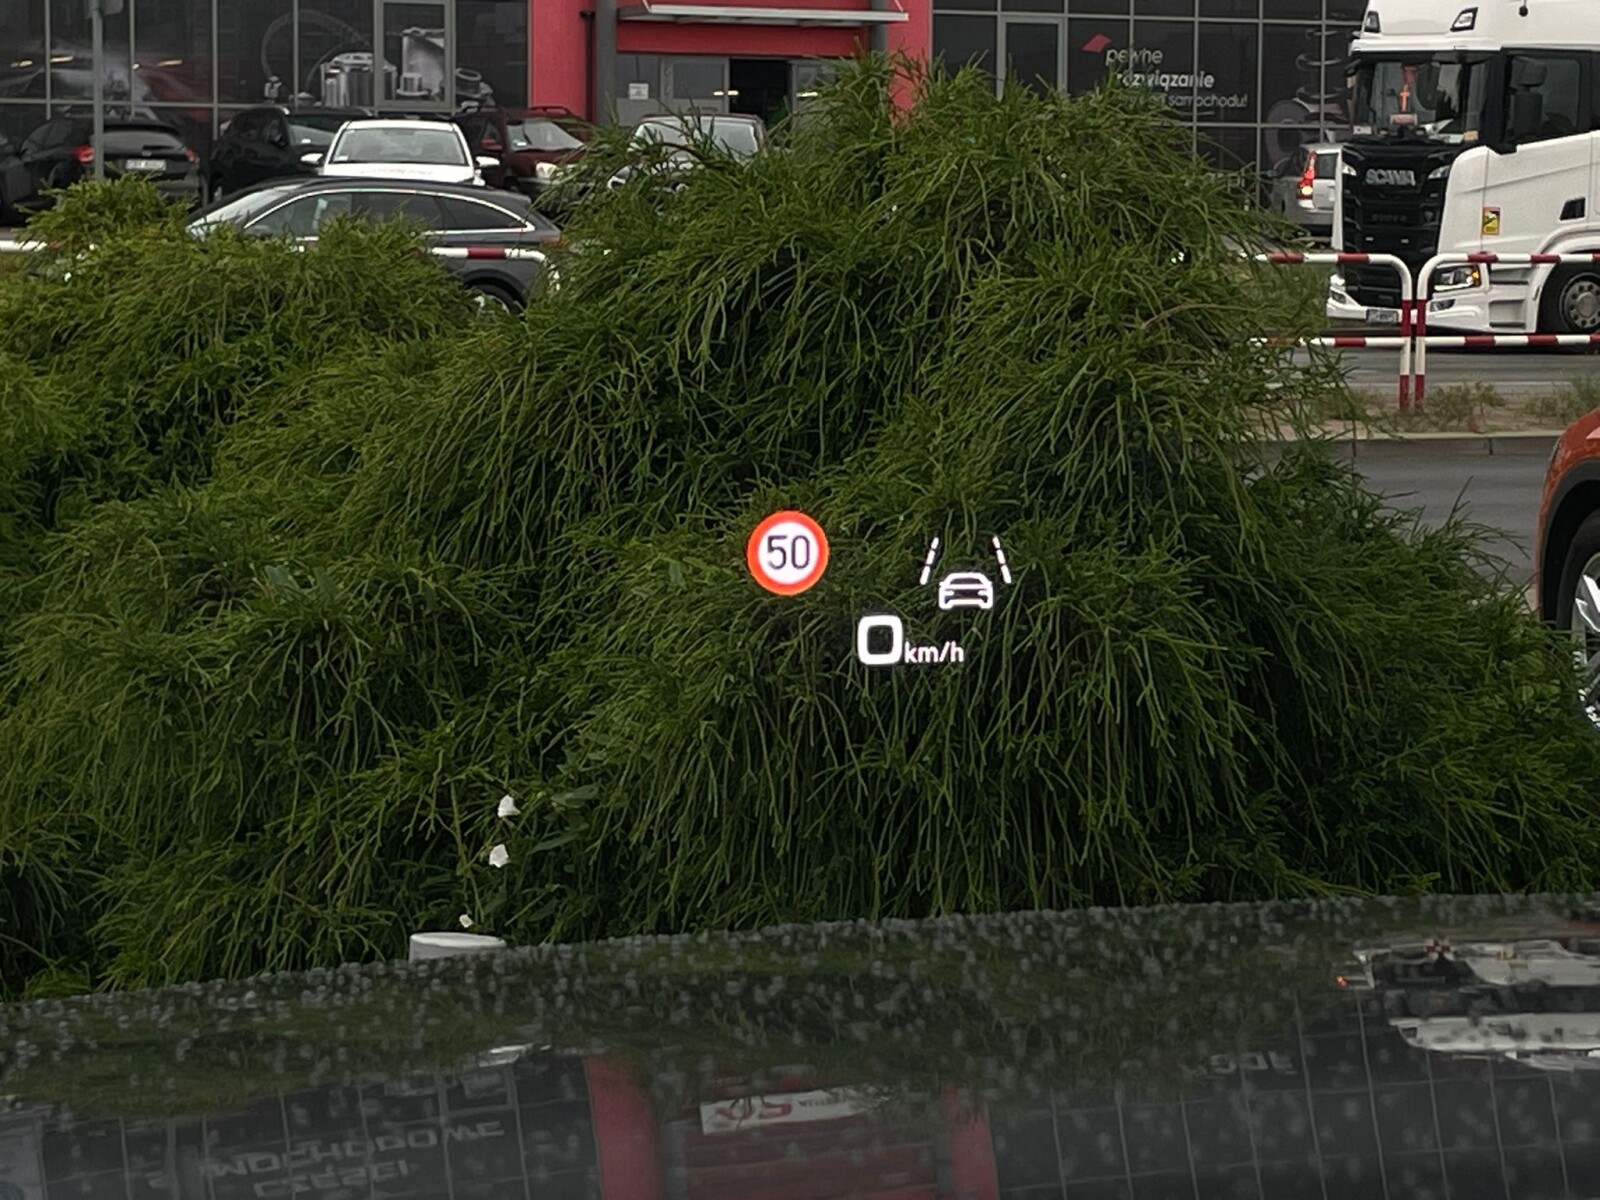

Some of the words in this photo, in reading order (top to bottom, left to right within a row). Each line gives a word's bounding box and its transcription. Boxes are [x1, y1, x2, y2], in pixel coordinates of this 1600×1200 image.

[1365, 168, 1416, 186] SCANIA
[767, 535, 811, 570] 50
[904, 641, 964, 664] km/h
